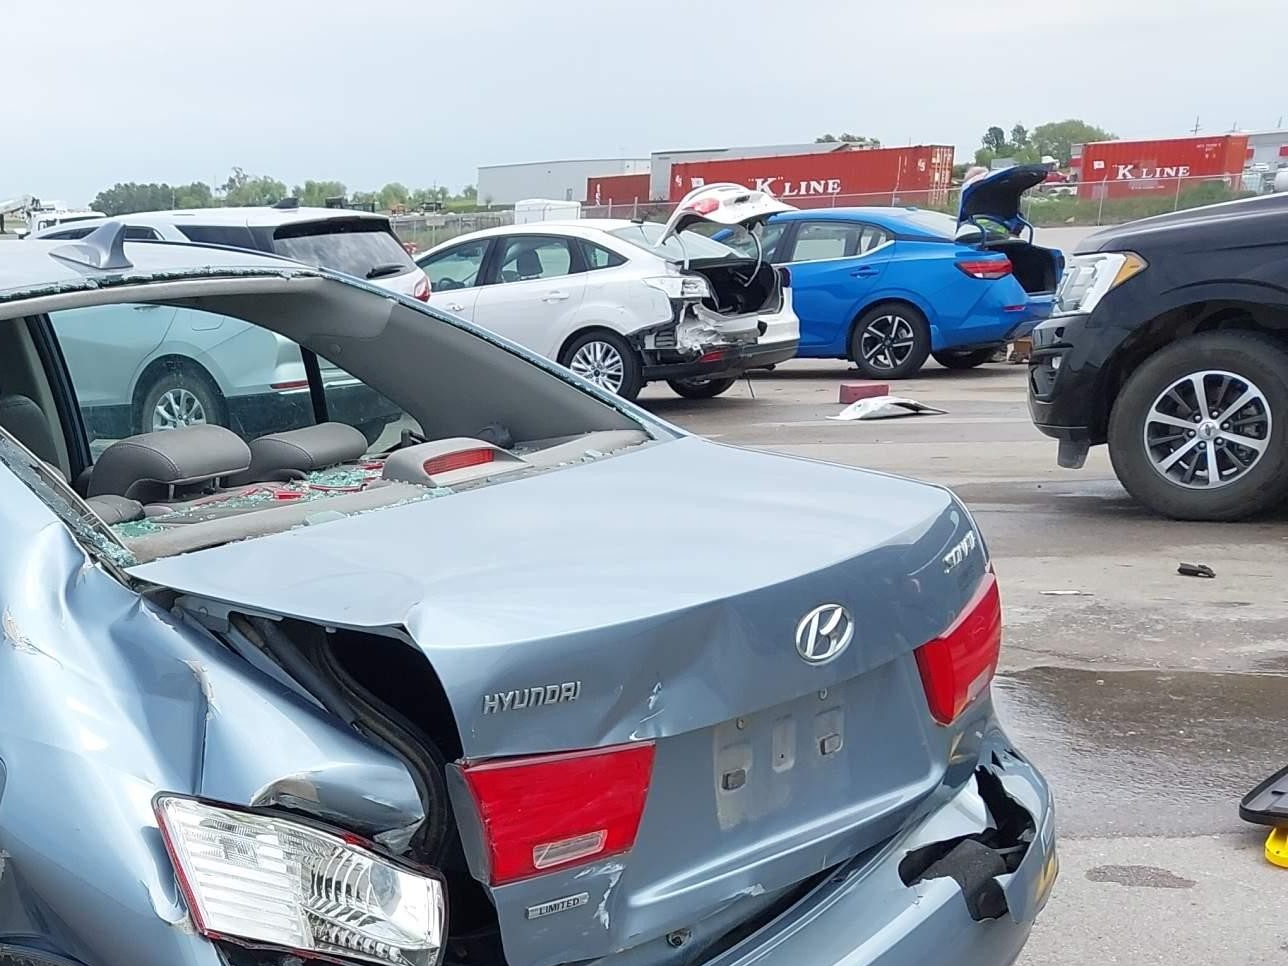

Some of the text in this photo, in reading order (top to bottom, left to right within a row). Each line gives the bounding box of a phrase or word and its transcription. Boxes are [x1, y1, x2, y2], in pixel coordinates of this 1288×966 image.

[1141, 166, 1190, 178] LINE
[783, 178, 842, 196] LINE
[483, 681, 582, 715] HYUNDAI
[538, 897, 580, 916] LIMITED
